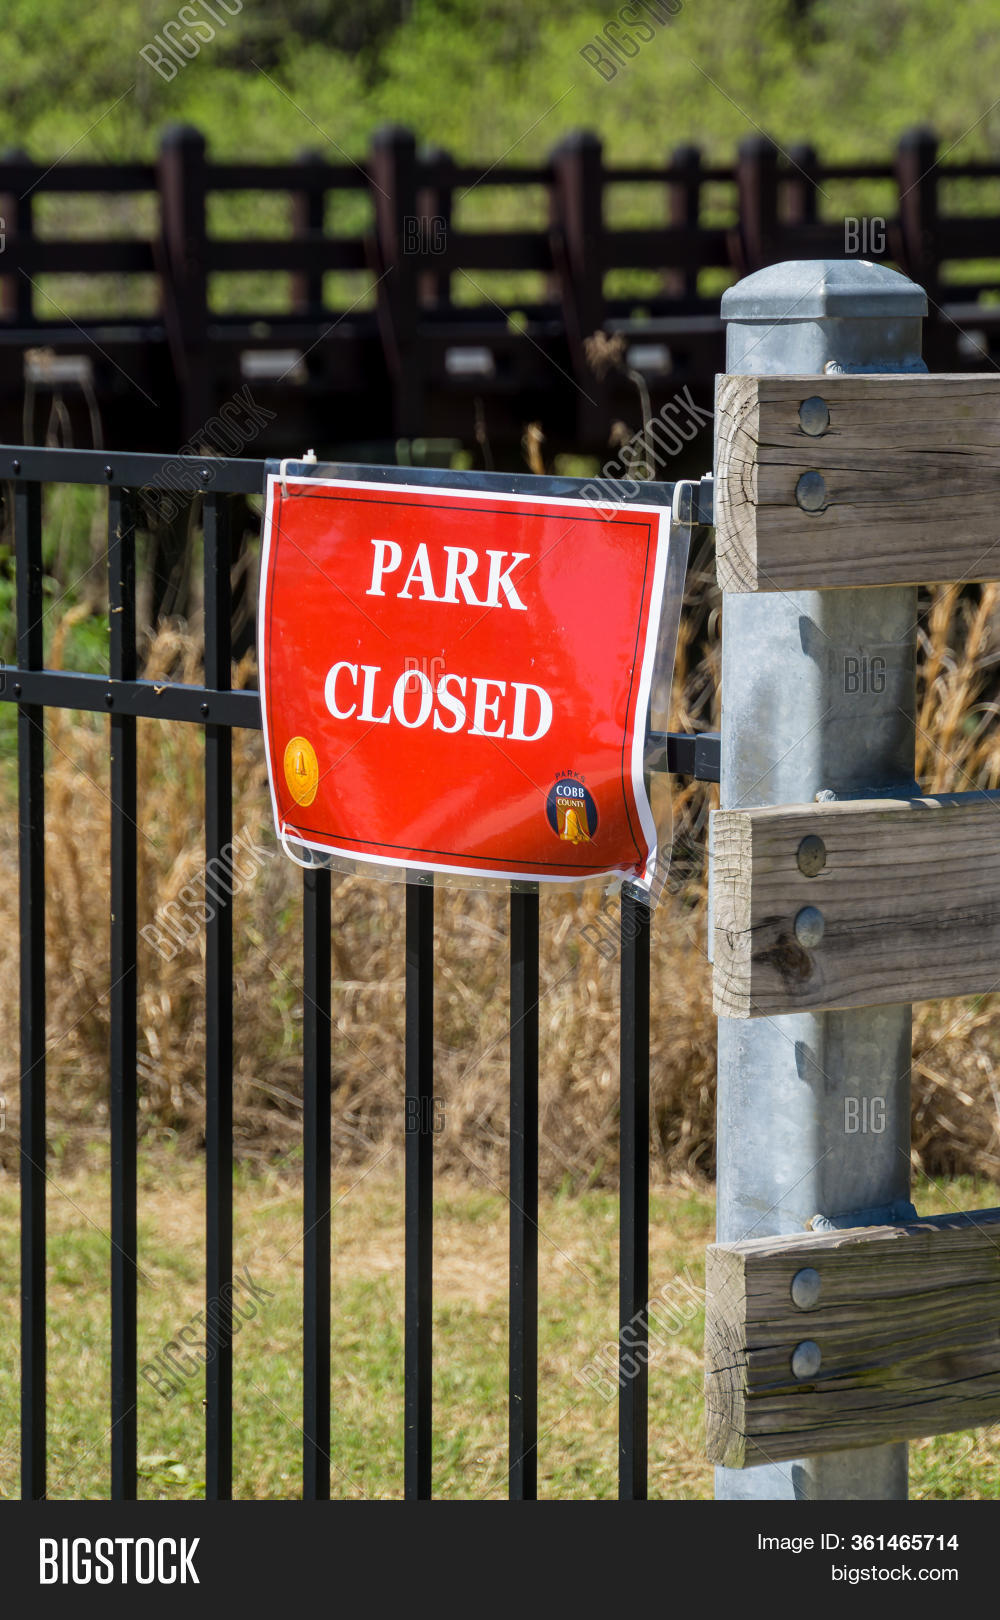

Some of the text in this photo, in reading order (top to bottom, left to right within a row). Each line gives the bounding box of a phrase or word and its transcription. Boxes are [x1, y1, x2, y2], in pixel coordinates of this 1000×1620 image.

[366, 539, 530, 610] PARK
[324, 661, 553, 741] CLOSED
[554, 769, 586, 784] PARKS
[556, 785, 585, 798] COBB
[557, 798, 585, 808] COUNTY
